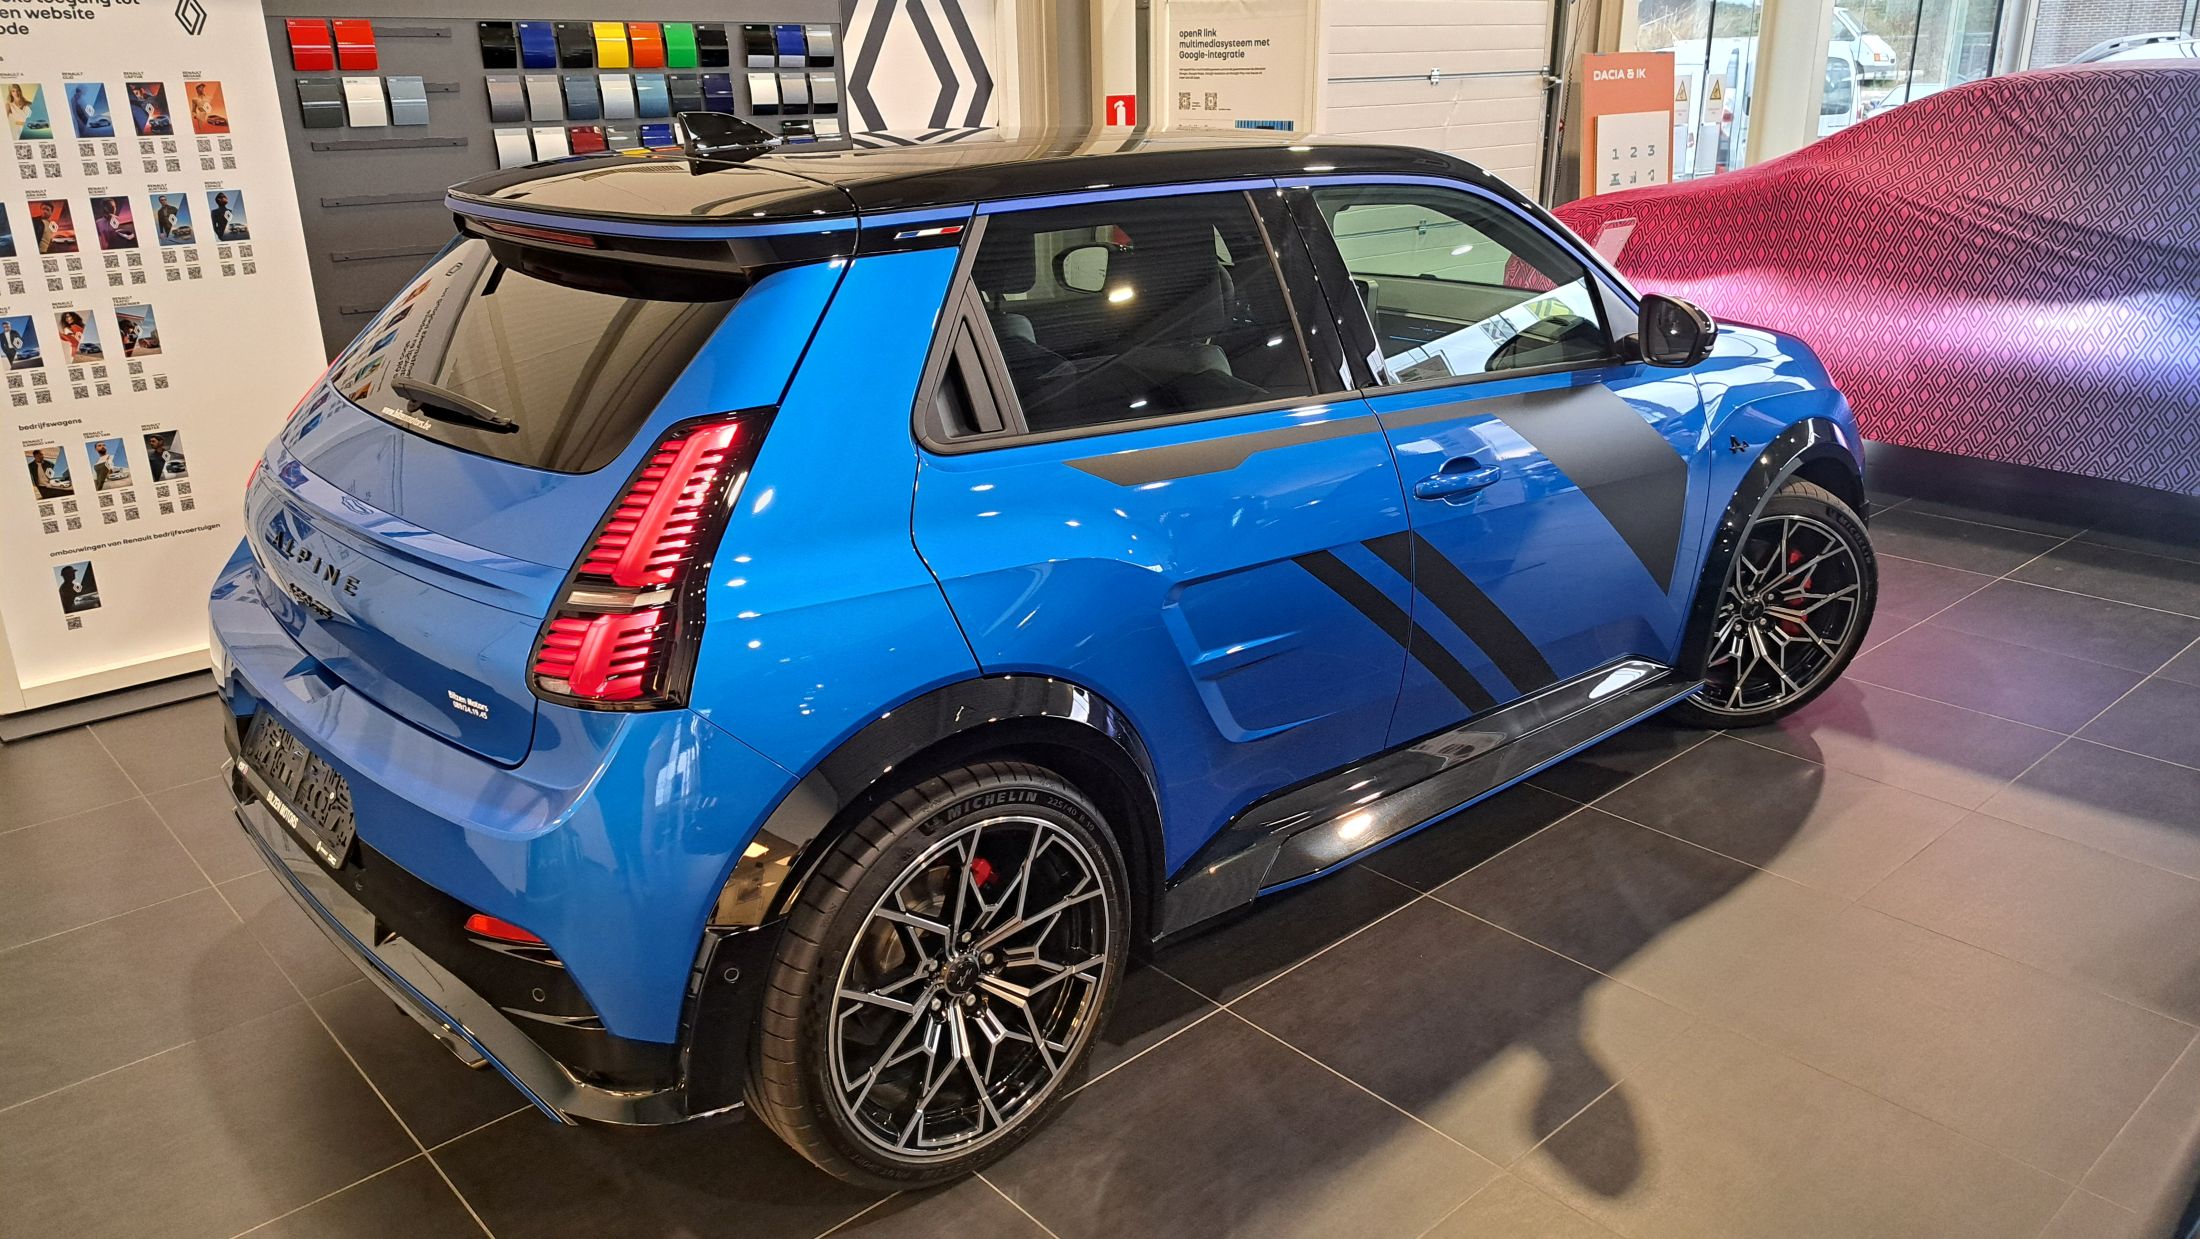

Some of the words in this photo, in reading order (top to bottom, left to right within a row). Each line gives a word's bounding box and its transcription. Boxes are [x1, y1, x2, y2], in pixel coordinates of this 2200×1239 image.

[24, 6, 95, 20] website
[1179, 28, 1203, 39] openR
[1203, 28, 1217, 37] link
[1179, 39, 1253, 50] multimediasysteem
[1254, 38, 1270, 47] met
[1179, 49, 1245, 60] Google-integratie
[1593, 69, 1625, 81] DACIA
[1626, 68, 1635, 79] &
[1636, 67, 1646, 79] IK
[1612, 148, 1619, 160] 1
[1630, 146, 1638, 158] 2
[1647, 144, 1655, 157] 3
[18, 418, 83, 431] bedrijfswagens
[49, 543, 106, 558] ombouwingen
[107, 540, 122, 548] van
[122, 535, 152, 545] Renault
[153, 523, 221, 539] bedrijfsvoertuigen
[272, 531, 361, 597] ALPINE
[266, 789, 282, 813] BILZEN
[280, 803, 299, 829] MOTORS
[947, 791, 1039, 821] MICHELIN
